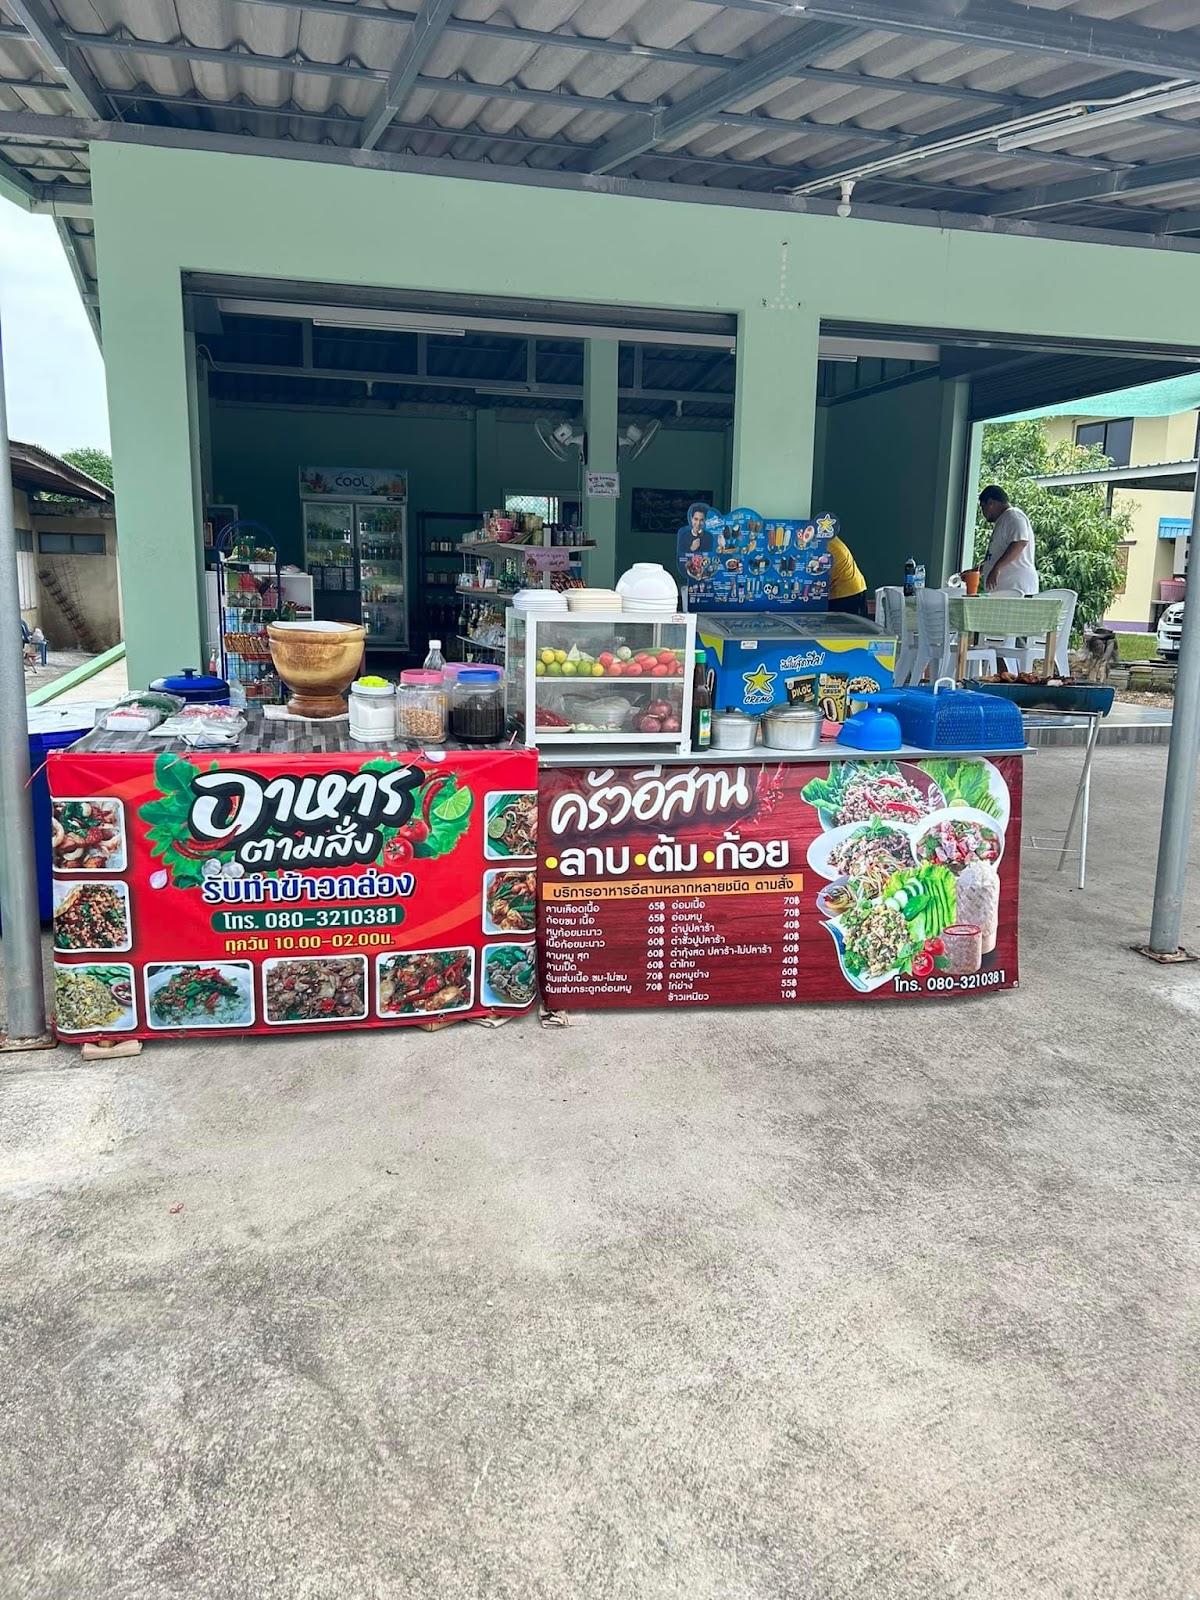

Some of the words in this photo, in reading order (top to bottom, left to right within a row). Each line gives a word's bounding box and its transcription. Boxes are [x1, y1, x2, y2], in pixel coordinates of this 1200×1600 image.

[744, 694, 774, 705] CREMO
[192, 768, 412, 838] อาหาร
[551, 765, 749, 834] ครัวอีสาน
[241, 815, 374, 863] ตามสั่ง
[559, 846, 630, 876] ลาบ
[646, 834, 698, 873] ต้ม
[716, 831, 789, 870] ก้อย
[203, 870, 415, 902] รับทำข้าวกล่อง
[553, 879, 749, 898] บริการอาหารอีสานหลากหลายชนิด
[755, 875, 794, 891] ตามสั่ง
[545, 901, 600, 913] ลาบเลือดเนื้อ
[671, 897, 706, 909] อ่อมเนื้อ
[223, 911, 259, 930] โทร.
[265, 908, 397, 928] 080-3210381
[579, 913, 595, 925] เนื้อ
[671, 912, 703, 923] อ่อมหมู
[546, 927, 603, 938] หมูก้อยมะนาว
[671, 923, 715, 935] ตำปูปลาร้า
[225, 937, 269, 954] ทุกวัน
[545, 936, 606, 949] เนื้อก้อยมะนาว
[670, 948, 705, 959] ตำกุ้งสด
[546, 961, 577, 972] ลาบเป็ด
[669, 959, 696, 969] ตำไทย
[669, 970, 710, 981] คอหมูย่าง
[893, 975, 922, 992] โทร.
[927, 970, 1006, 991] 080-3210381
[668, 981, 693, 990] ไก่ย่าง
[667, 991, 710, 1002] ข้าวเหนียว
